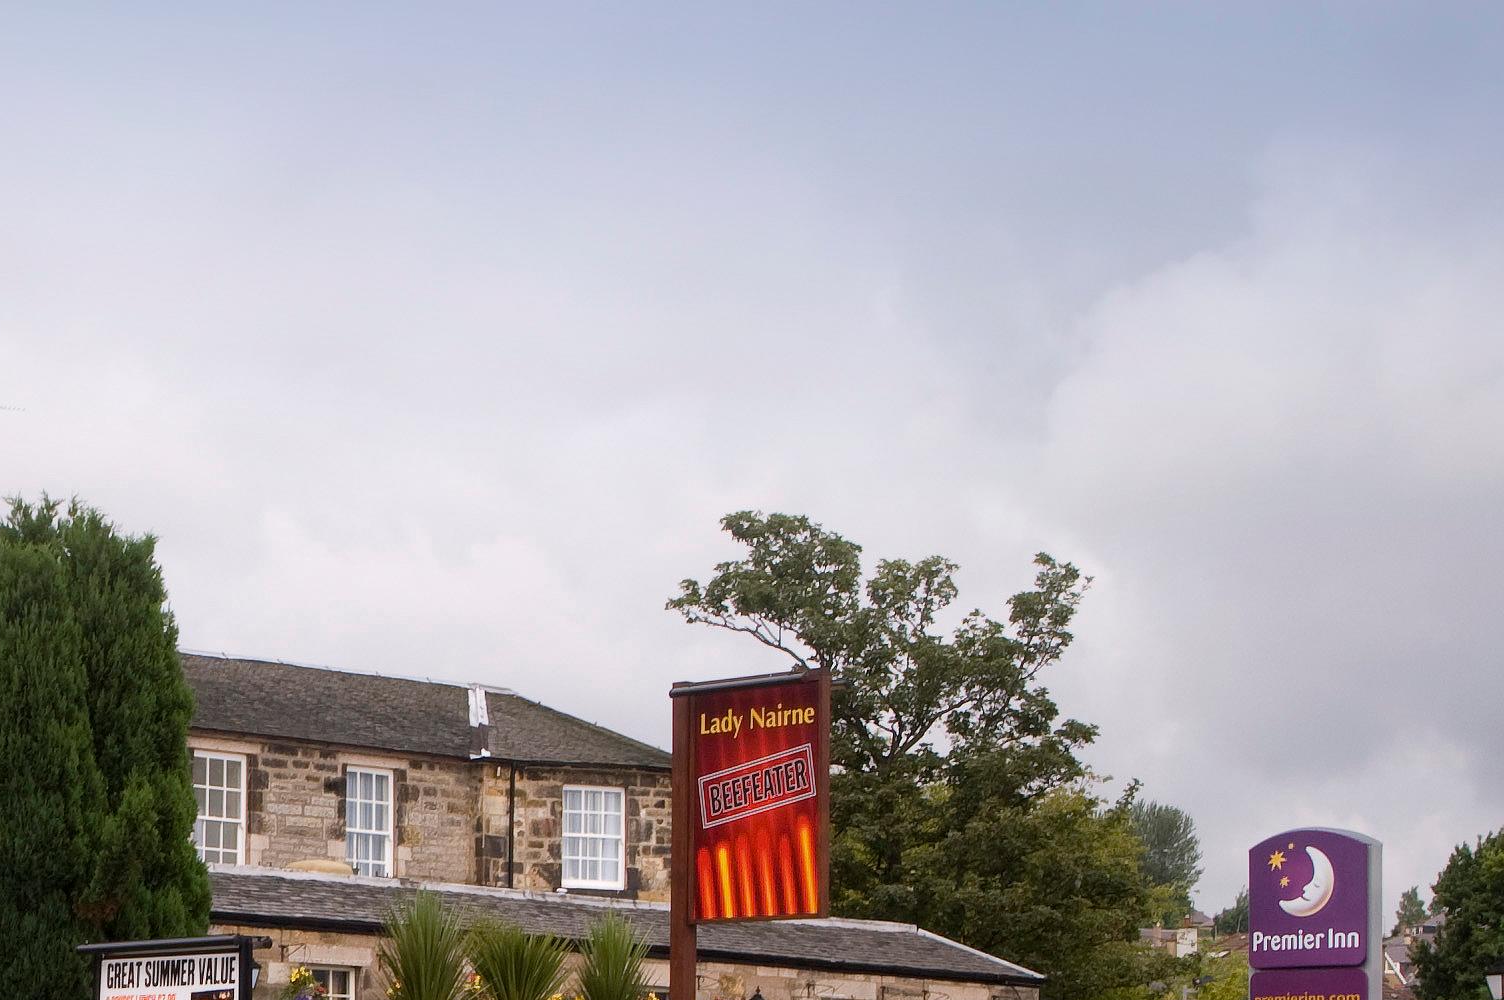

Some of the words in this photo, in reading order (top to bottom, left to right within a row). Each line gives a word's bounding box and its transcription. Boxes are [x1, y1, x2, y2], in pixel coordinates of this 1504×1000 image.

[700, 707, 744, 739] Lady
[749, 702, 815, 730] Nairne
[708, 757, 809, 817] BEEFEATER
[1252, 929, 1325, 952] Premier
[1328, 927, 1360, 949] Inn
[107, 962, 143, 989] GREAT
[145, 959, 196, 988] SUMMER
[199, 956, 237, 985] VALUE
